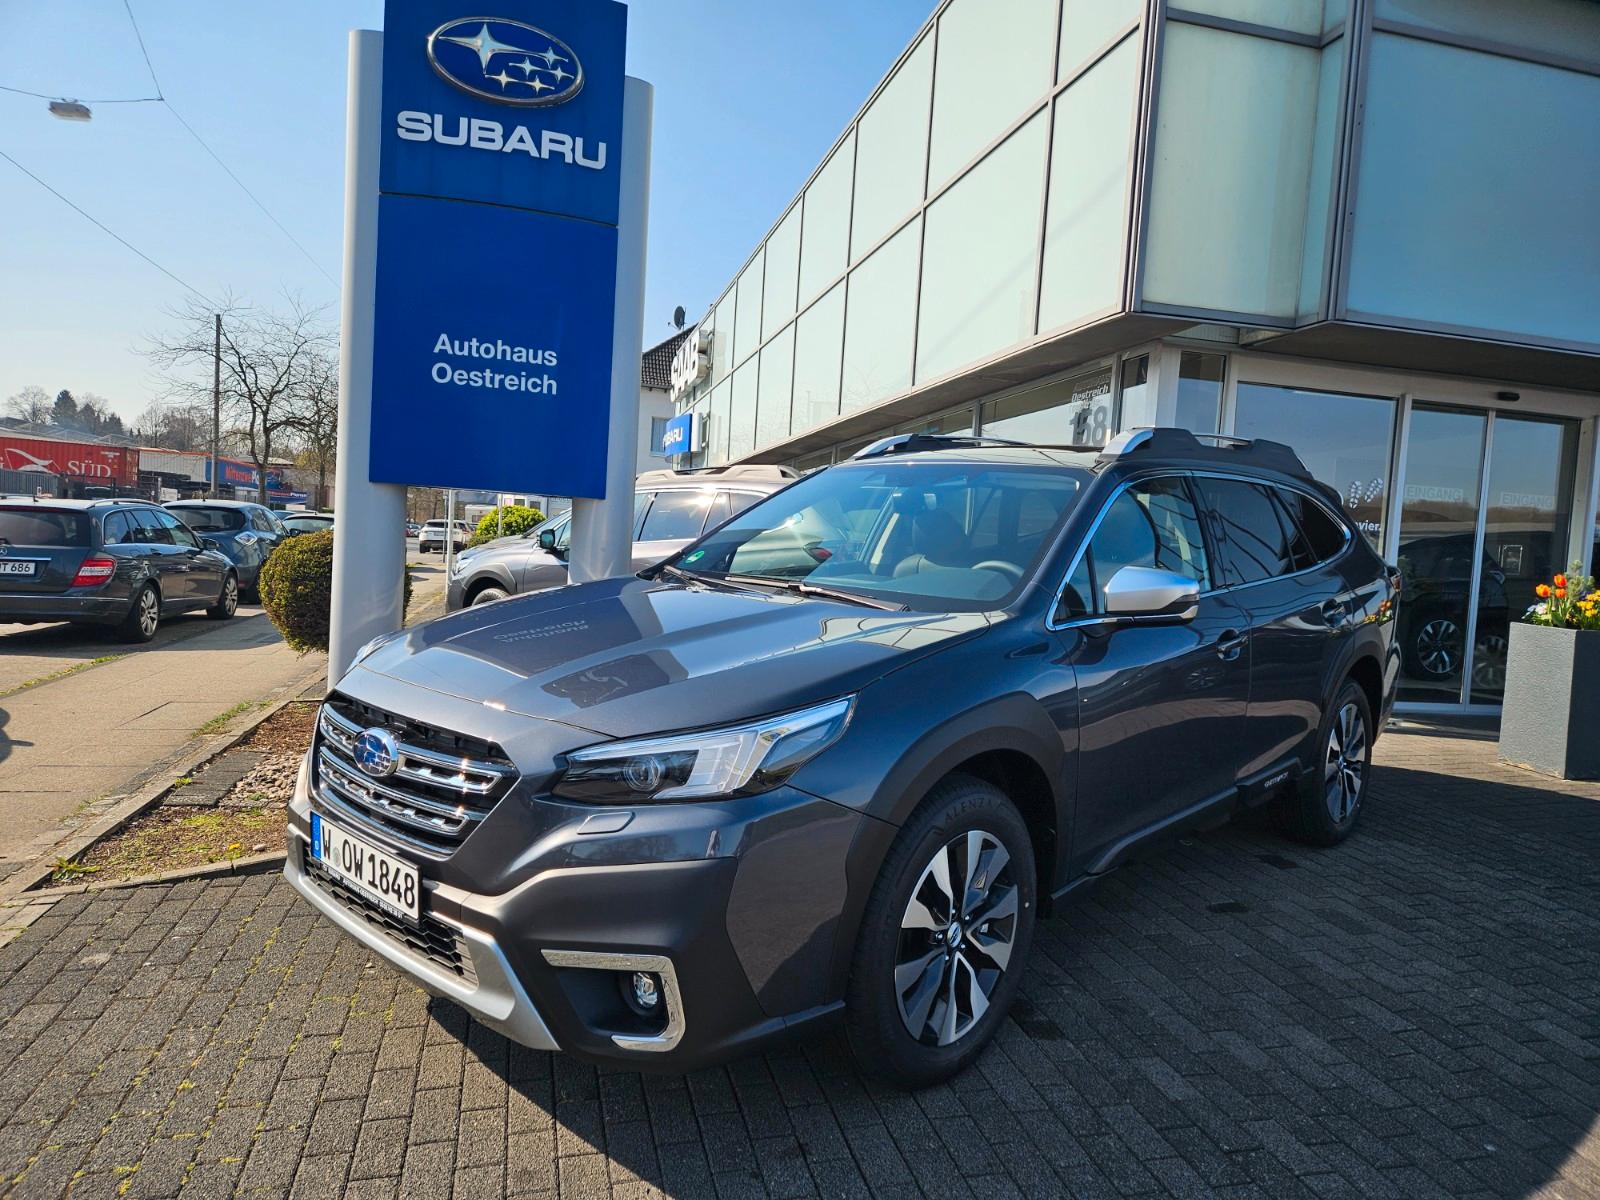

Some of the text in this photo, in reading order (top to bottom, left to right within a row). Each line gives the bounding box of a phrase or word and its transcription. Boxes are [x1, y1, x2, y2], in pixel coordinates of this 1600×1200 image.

[397, 110, 607, 170] SUBARU
[433, 333, 558, 367] Autohaus
[431, 362, 557, 395] Oestreich
[67, 460, 111, 478] SÜD
[1407, 487, 1463, 501] EINGANG
[1502, 493, 1554, 507] EINGANG
[11, 563, 30, 572] 686
[321, 825, 332, 860] W
[342, 838, 364, 880] OW
[367, 853, 416, 909] 1848
